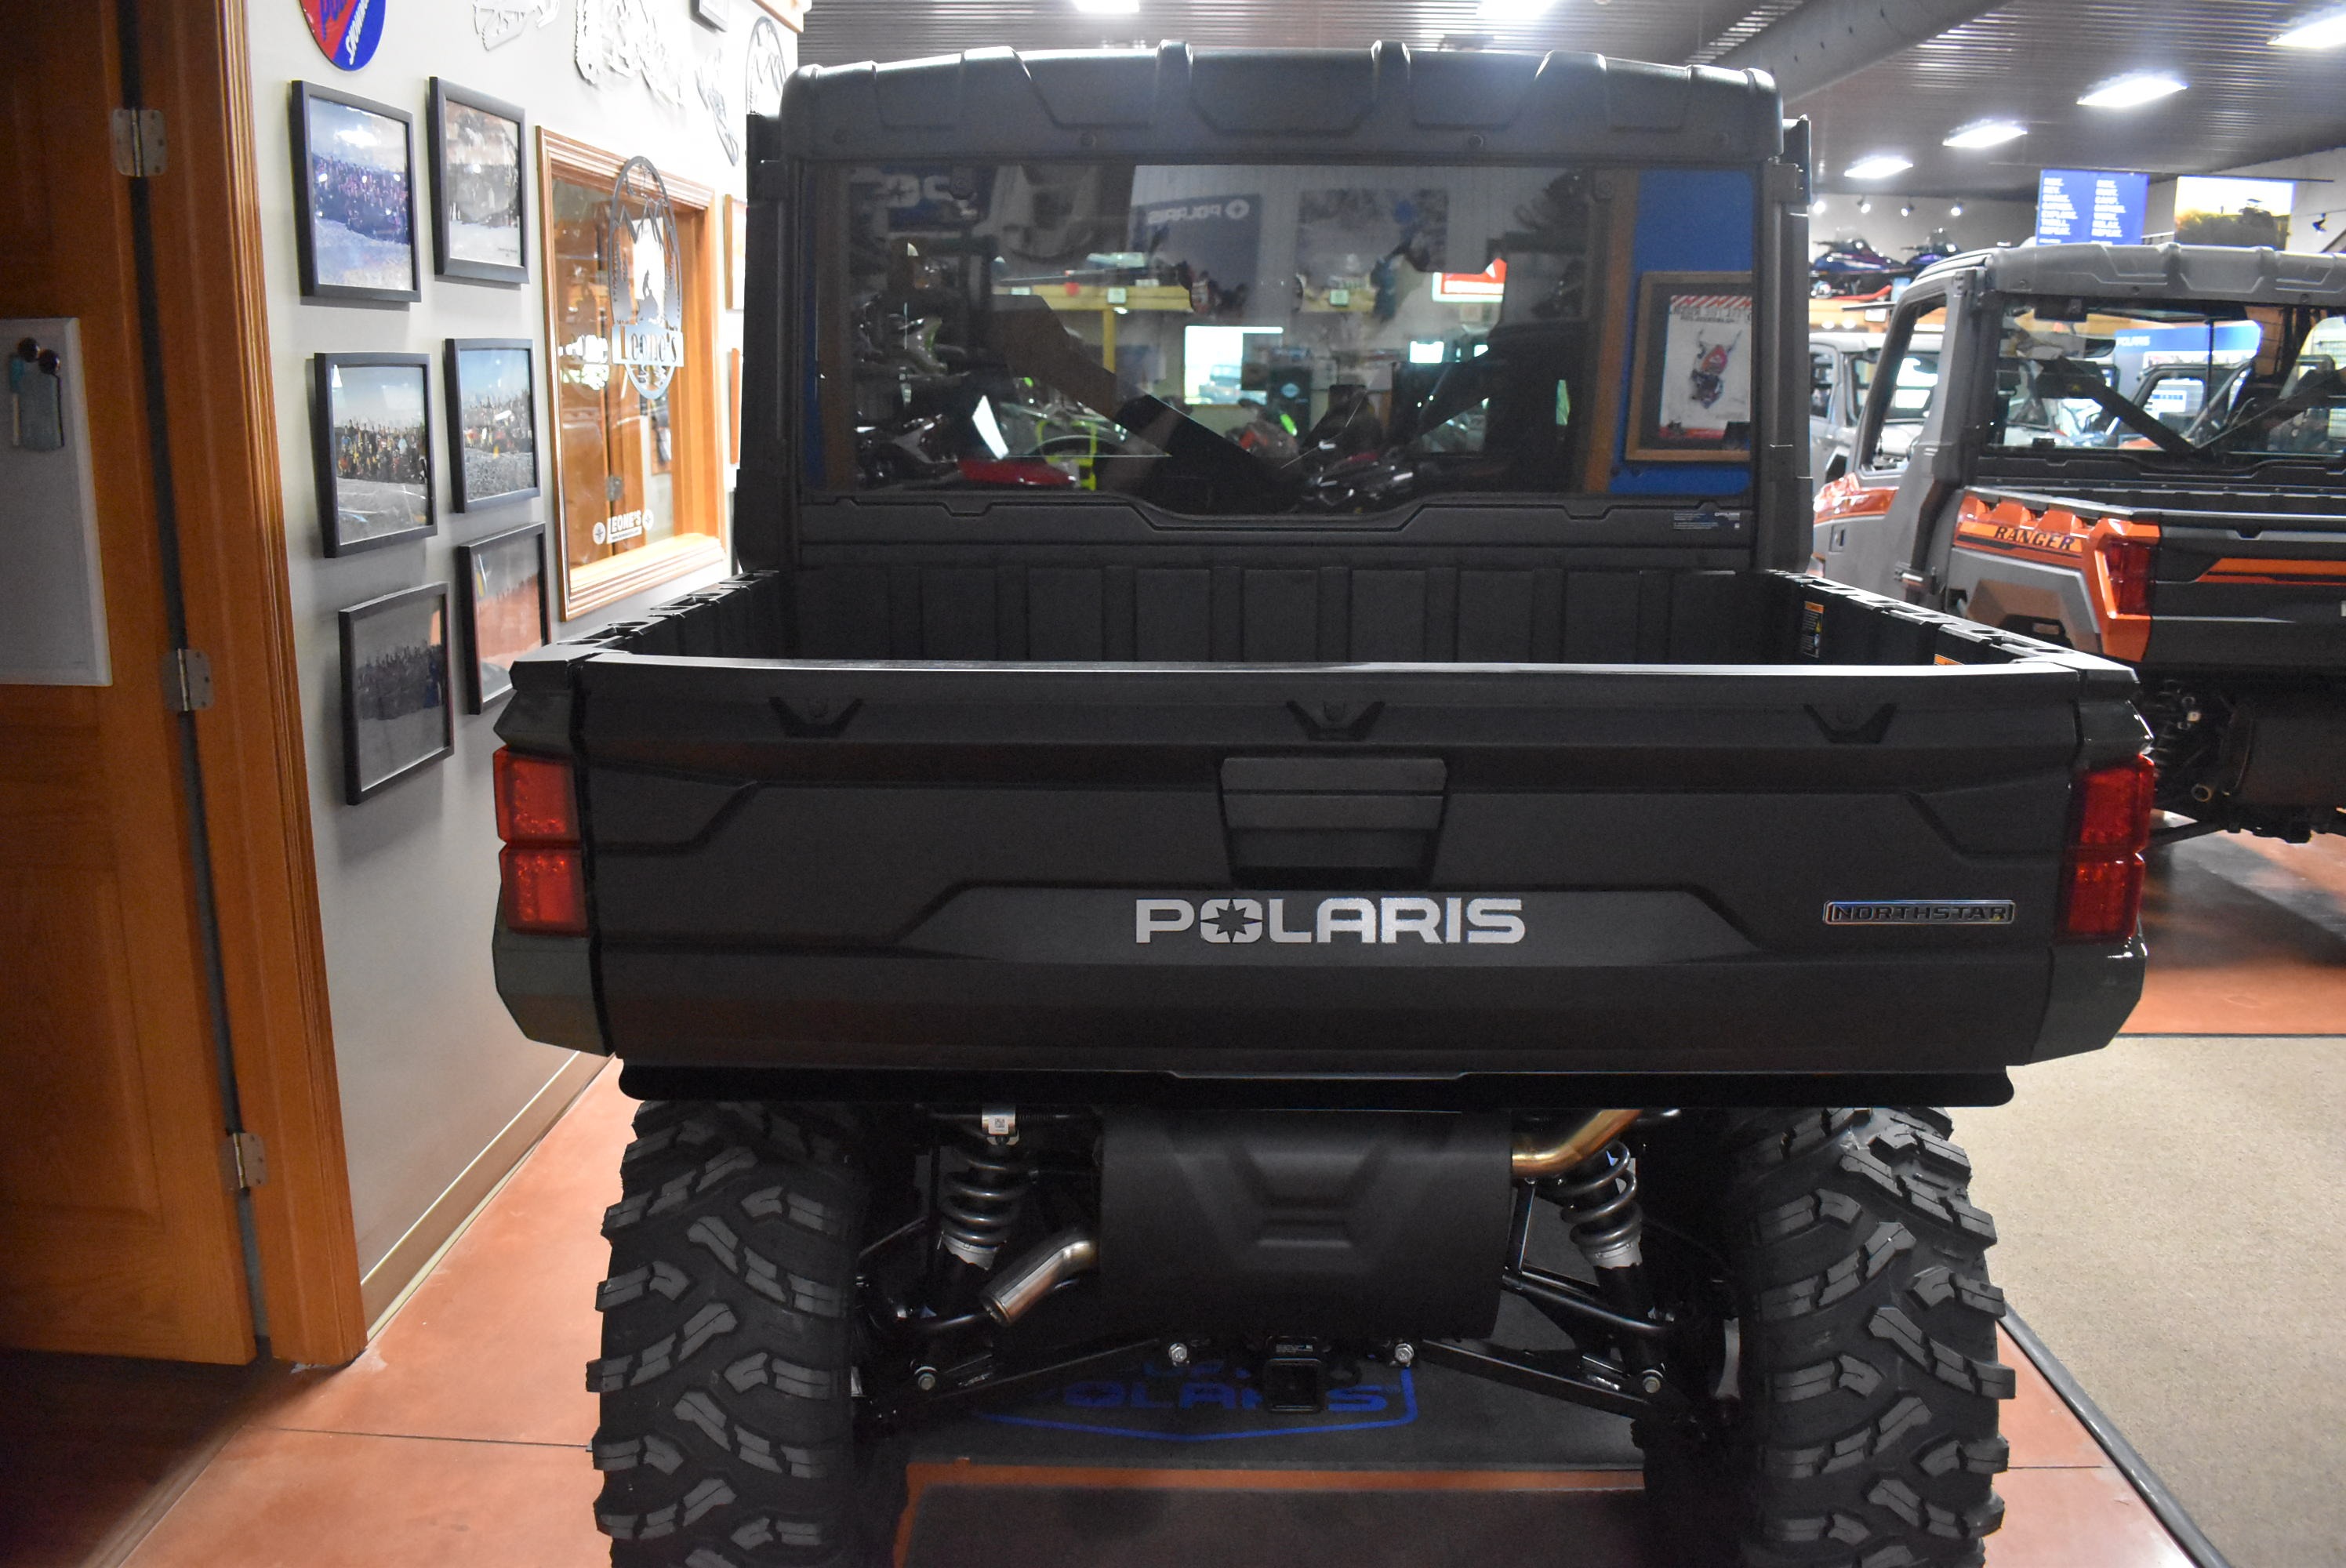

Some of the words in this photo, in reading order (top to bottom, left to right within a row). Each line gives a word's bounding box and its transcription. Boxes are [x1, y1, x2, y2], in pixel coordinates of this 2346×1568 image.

[607, 510, 642, 535] LEONE'S
[1994, 526, 2075, 550] RANGER
[1135, 898, 1526, 944] POLARIS
[1832, 906, 2008, 922] NORTHSTAR
